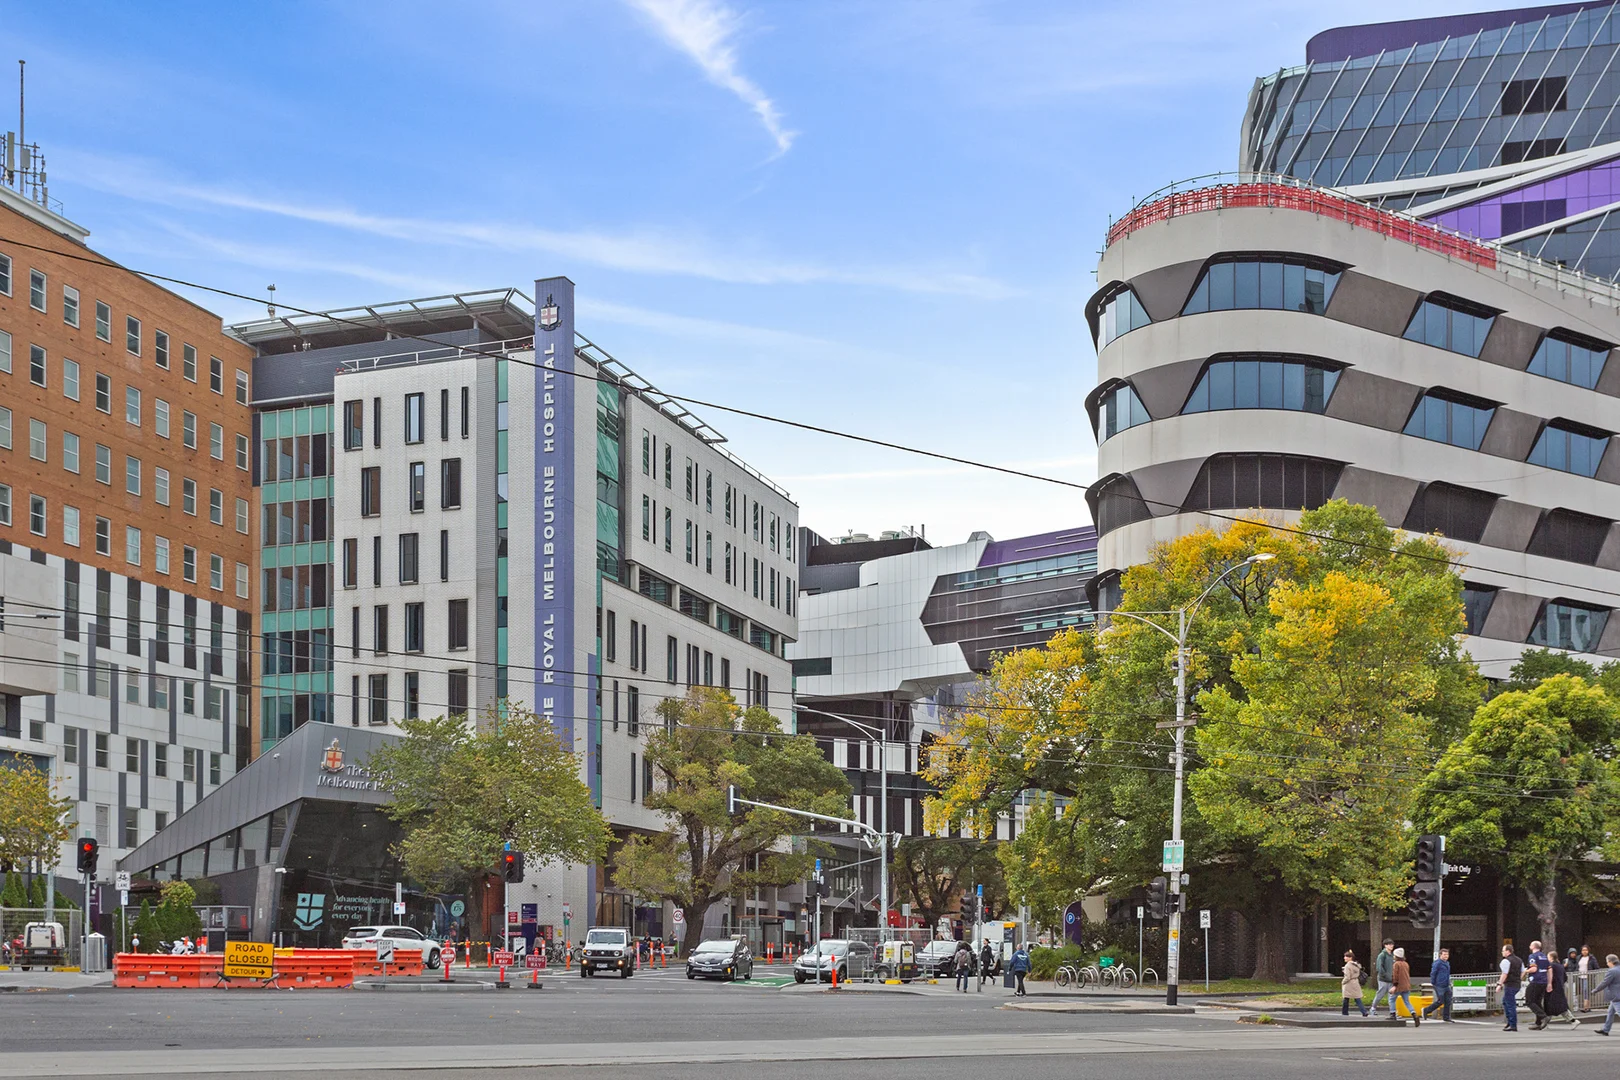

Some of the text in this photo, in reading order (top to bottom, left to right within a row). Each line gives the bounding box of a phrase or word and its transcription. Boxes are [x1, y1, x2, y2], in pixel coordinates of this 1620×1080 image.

[543, 343, 555, 736] HE ROYAL MELBOURNE HOSPITAL
[346, 764, 364, 776] The
[317, 774, 373, 790] Melbourne
[1448, 864, 1472, 875] Exit Only
[335, 895, 391, 905] Advancing health
[331, 902, 343, 912] for
[331, 912, 363, 922] every day
[235, 944, 264, 953] ROAD
[228, 954, 269, 964] CLOSED
